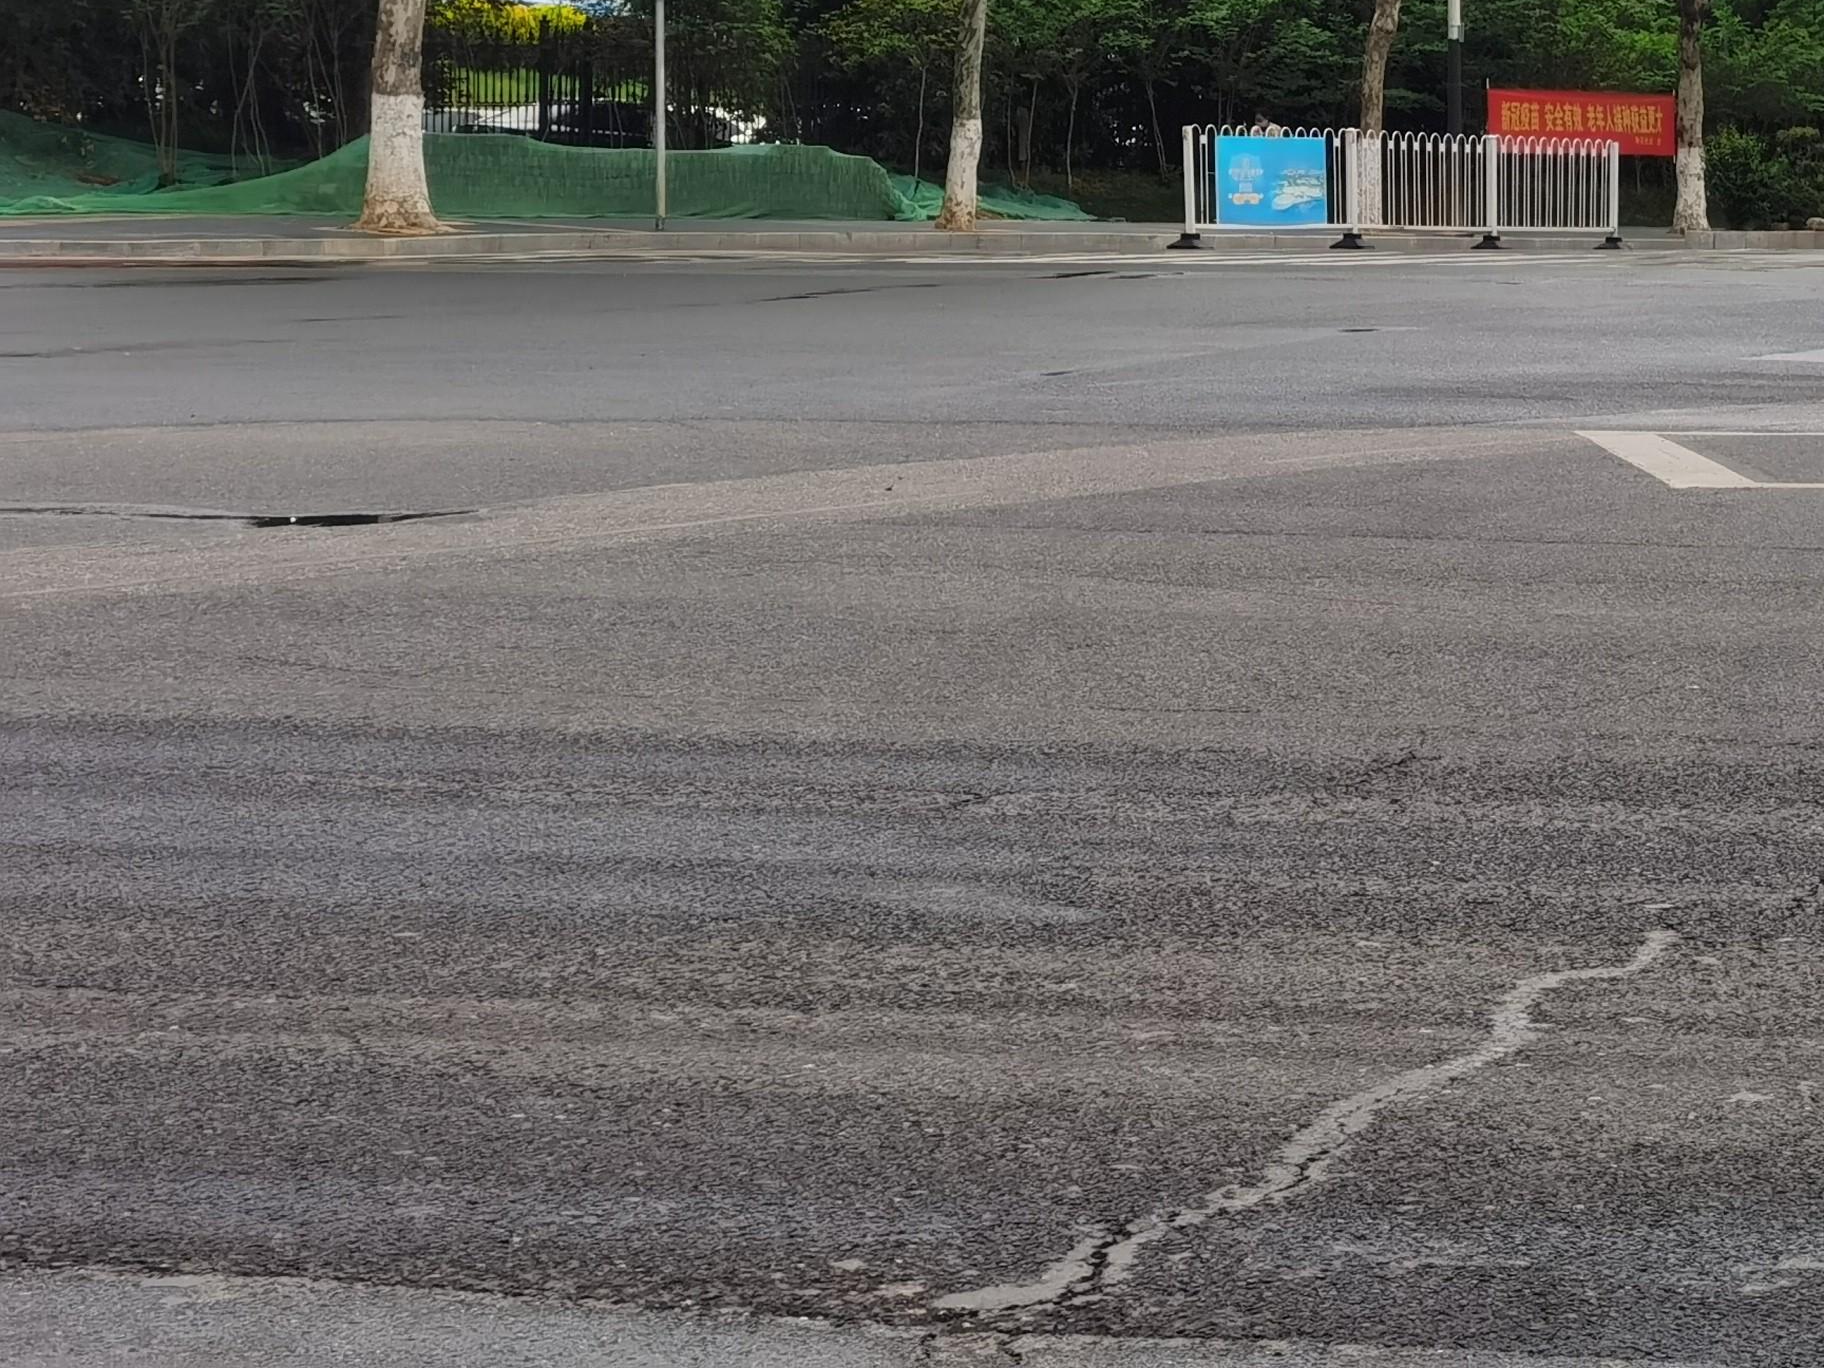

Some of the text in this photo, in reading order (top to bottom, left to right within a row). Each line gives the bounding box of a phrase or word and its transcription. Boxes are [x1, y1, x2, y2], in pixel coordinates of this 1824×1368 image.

[1501, 101, 1540, 132] 新冠疫苗
[1544, 102, 1583, 133] 安全有效
